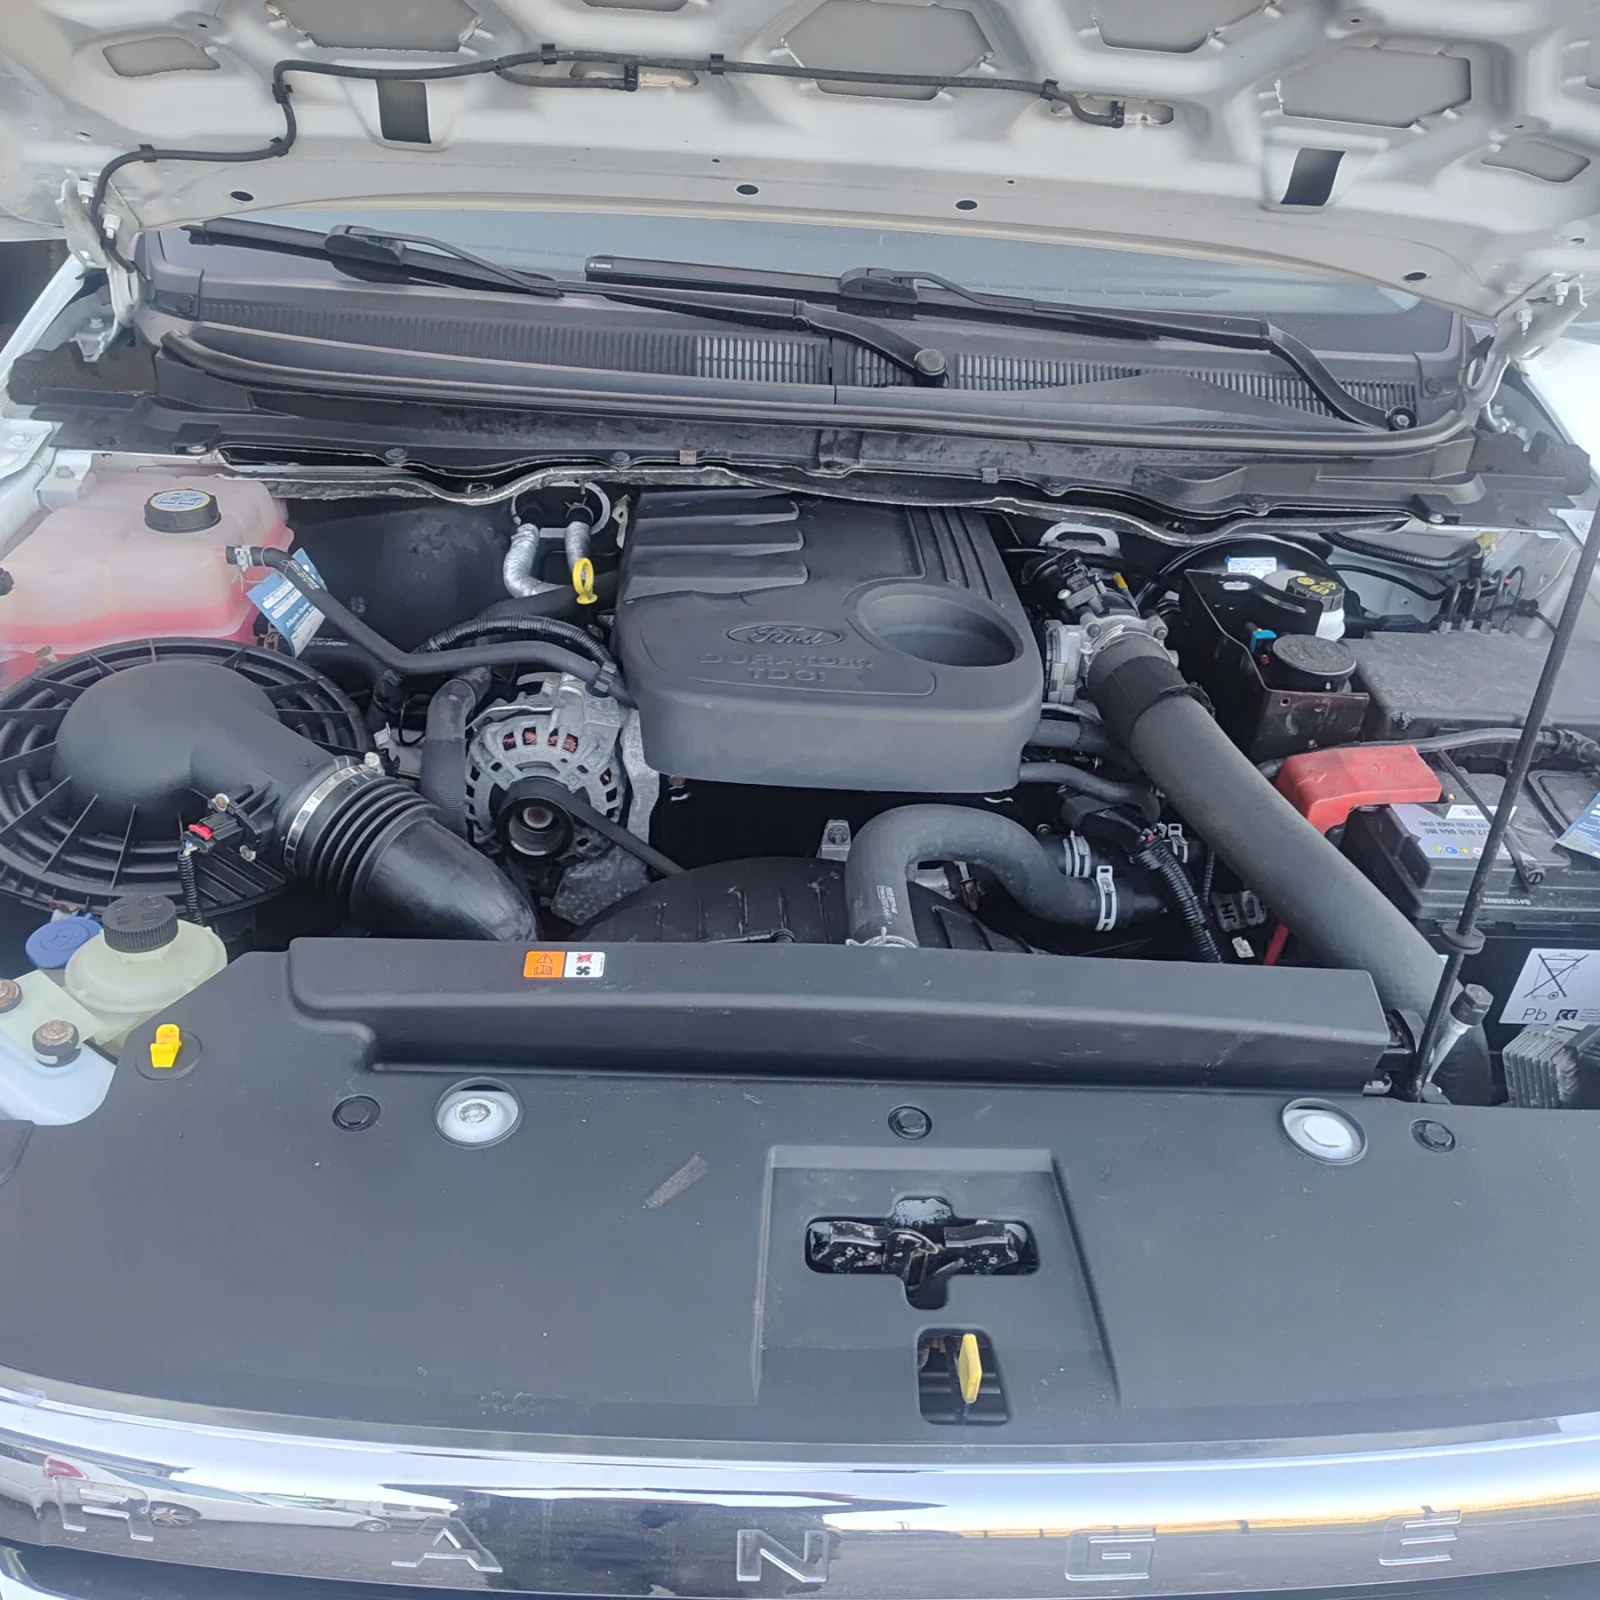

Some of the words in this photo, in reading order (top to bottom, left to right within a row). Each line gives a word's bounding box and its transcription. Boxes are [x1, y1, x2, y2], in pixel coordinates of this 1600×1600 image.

[750, 625, 823, 645] Ford
[700, 652, 875, 670] DURATORQ
[1521, 1007, 1548, 1021] Pb
[53, 1476, 1463, 1583] RANGE
